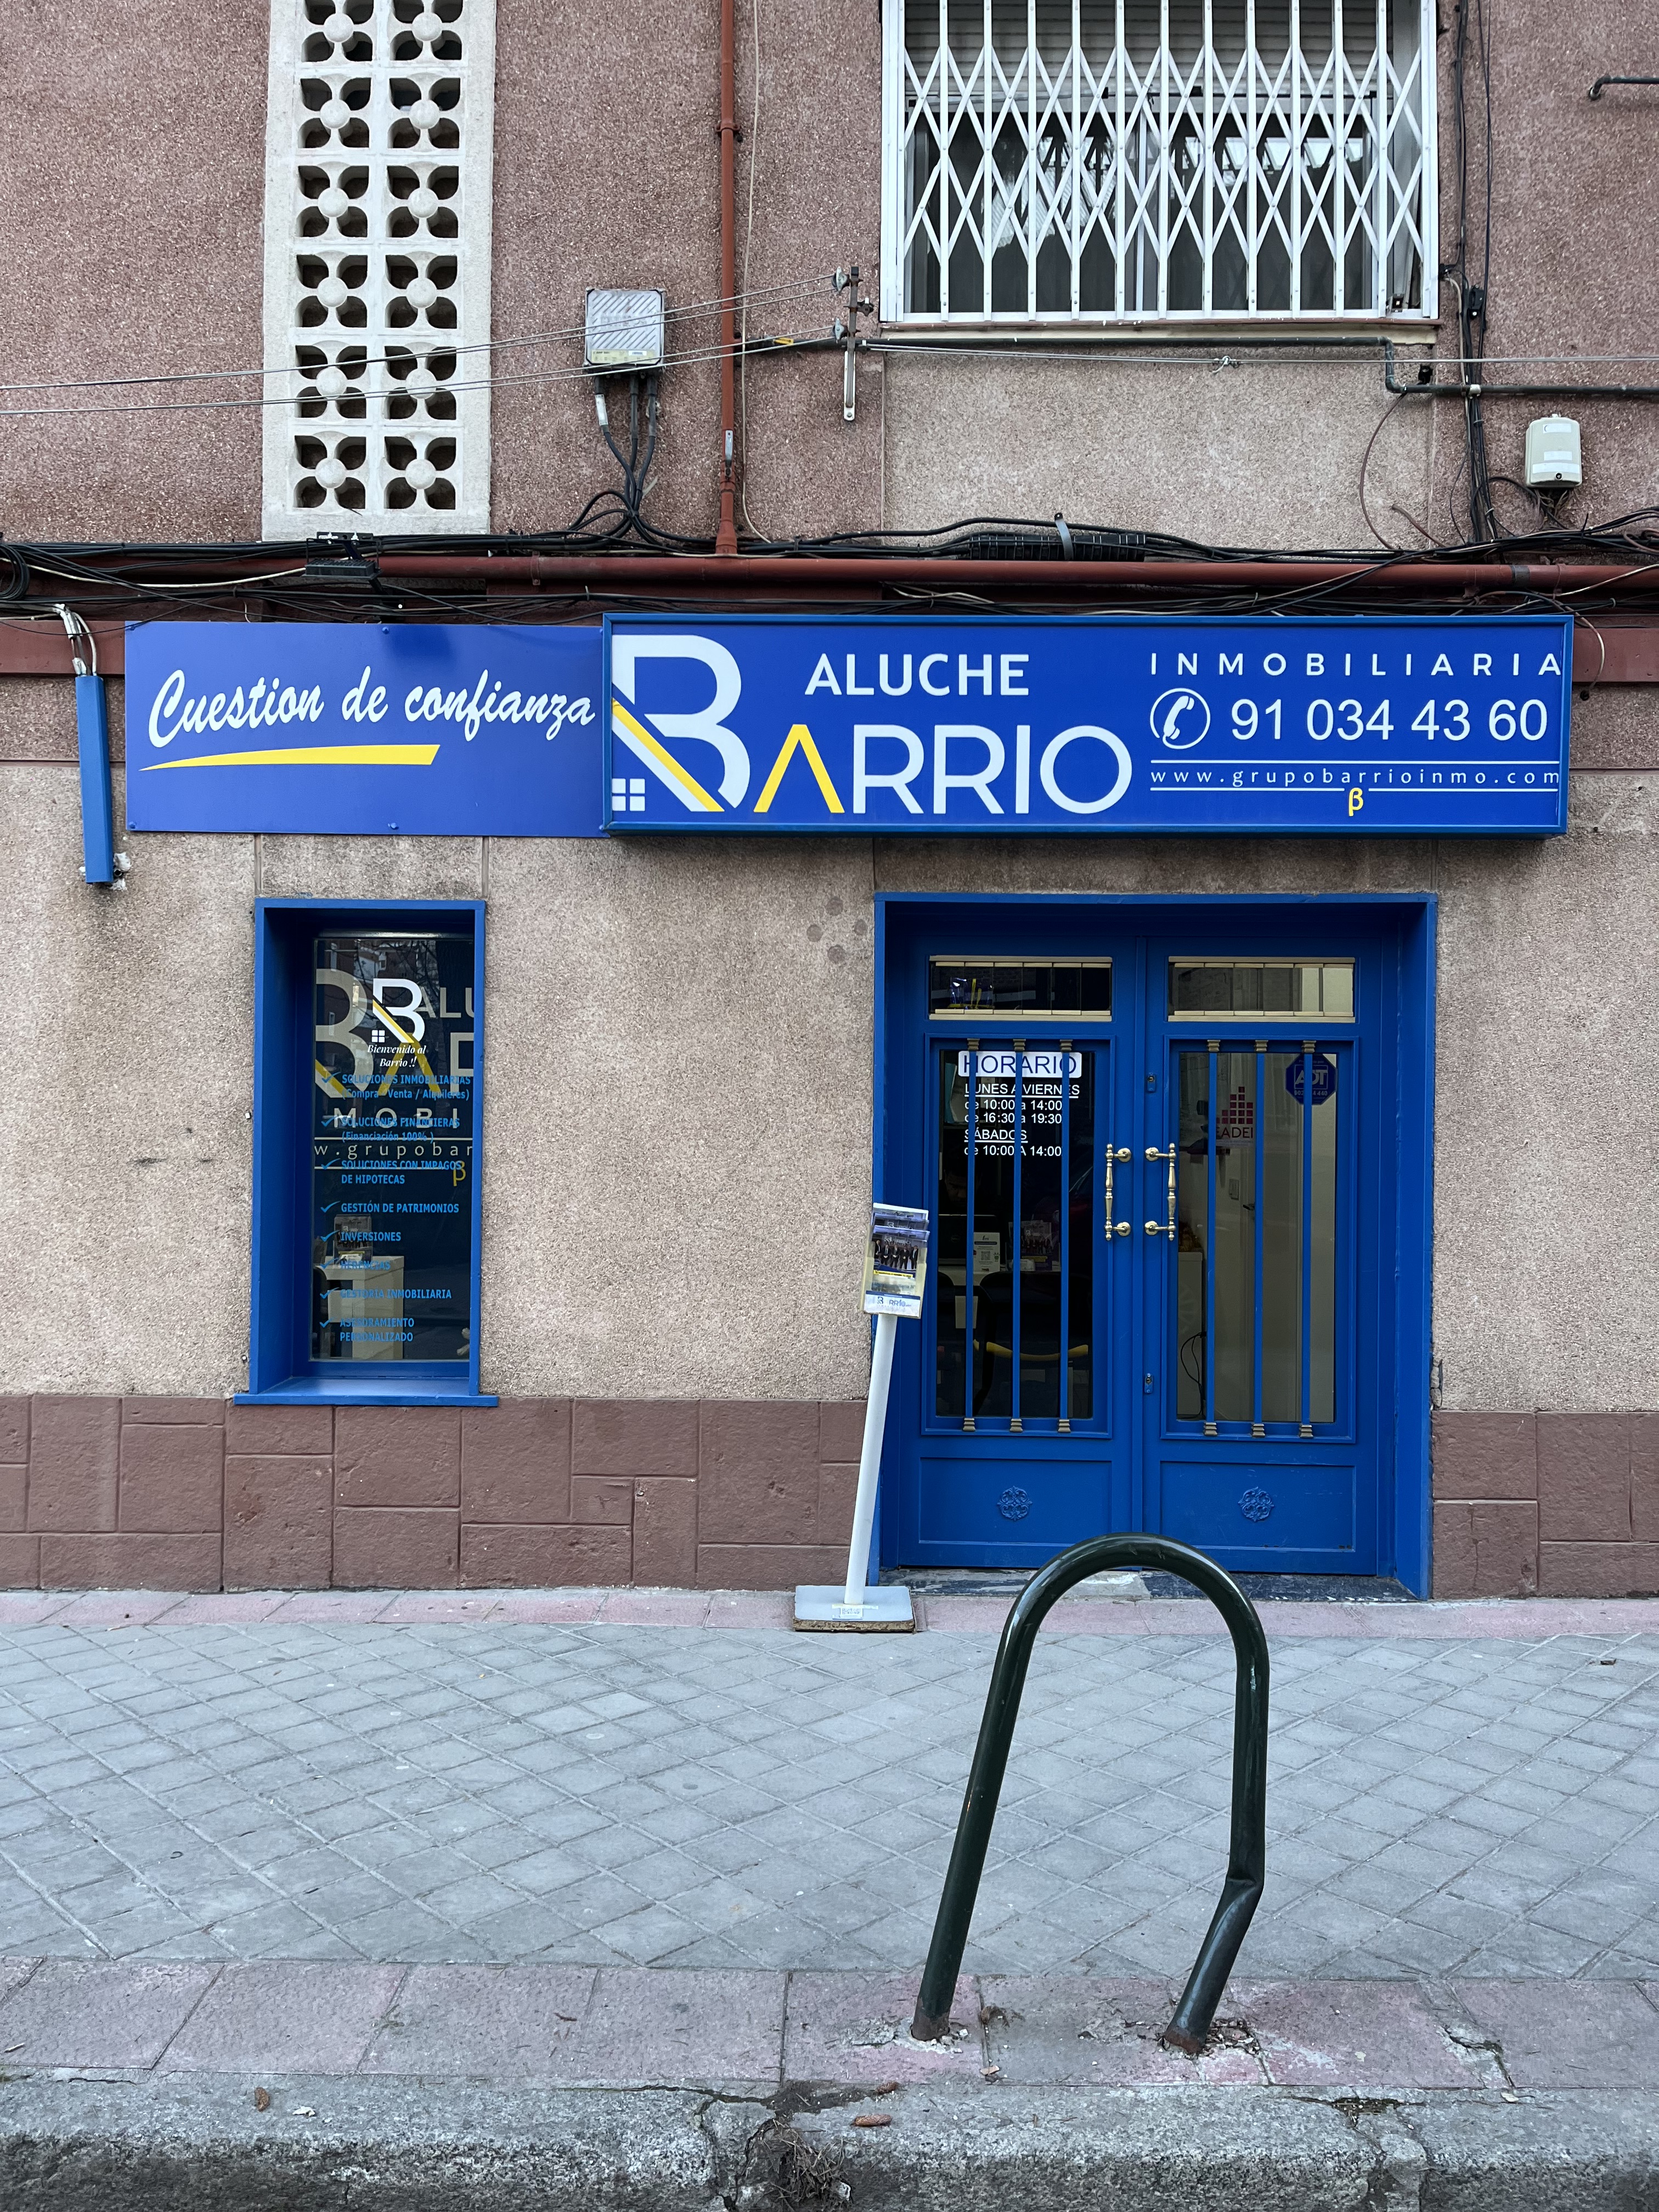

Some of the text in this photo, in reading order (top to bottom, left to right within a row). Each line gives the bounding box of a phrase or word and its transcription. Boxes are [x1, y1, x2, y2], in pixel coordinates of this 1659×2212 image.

[1151, 653, 1561, 676] INMOBILIARIA
[805, 653, 1030, 696] ALUCHE
[149, 665, 596, 748] Cuestion de confianza
[1231, 699, 1548, 741] 91 034 43 60
[1150, 768, 1559, 788] www.grupobarrioinmo.com
[367, 1044, 427, 1054] Bienvenido al
[379, 1058, 408, 1068] Barrio
[964, 1055, 1077, 1074] HORARIO
[341, 1074, 471, 1085] SOLUCIONES INMOBILIARIAS
[387, 1090, 413, 1099] Venta
[965, 1083, 1008, 1094] LUNES
[1023, 1084, 1080, 1095] VIERNS
[983, 1099, 1015, 1110] 10:00
[1030, 1099, 1063, 1110] 14:00
[342, 1116, 460, 1128] SOLUCIONES FINANCIERAS
[983, 1113, 1015, 1123] 16:30
[1031, 1113, 1062, 1124] 19:30
[341, 1130, 399, 1142] (Financiación
[402, 1131, 427, 1142] 100%
[964, 1126, 1027, 1140] SÁBADOS
[983, 1144, 1014, 1156] 10:00
[1030, 1146, 1062, 1156] 14:00
[341, 1159, 462, 1171] SOLUCIONES CON IMPAGOS
[341, 1175, 405, 1185] DE HIPOTECAS
[341, 1200, 460, 1214] GESTIÓN DE PATRIMONIOS
[341, 1231, 402, 1242] INVERSIONES
[387, 1289, 452, 1299] INMOBILIARIA
[340, 1318, 415, 1328] ASESORAMIENTO
[340, 1332, 413, 1342] PERSONALIZADO
